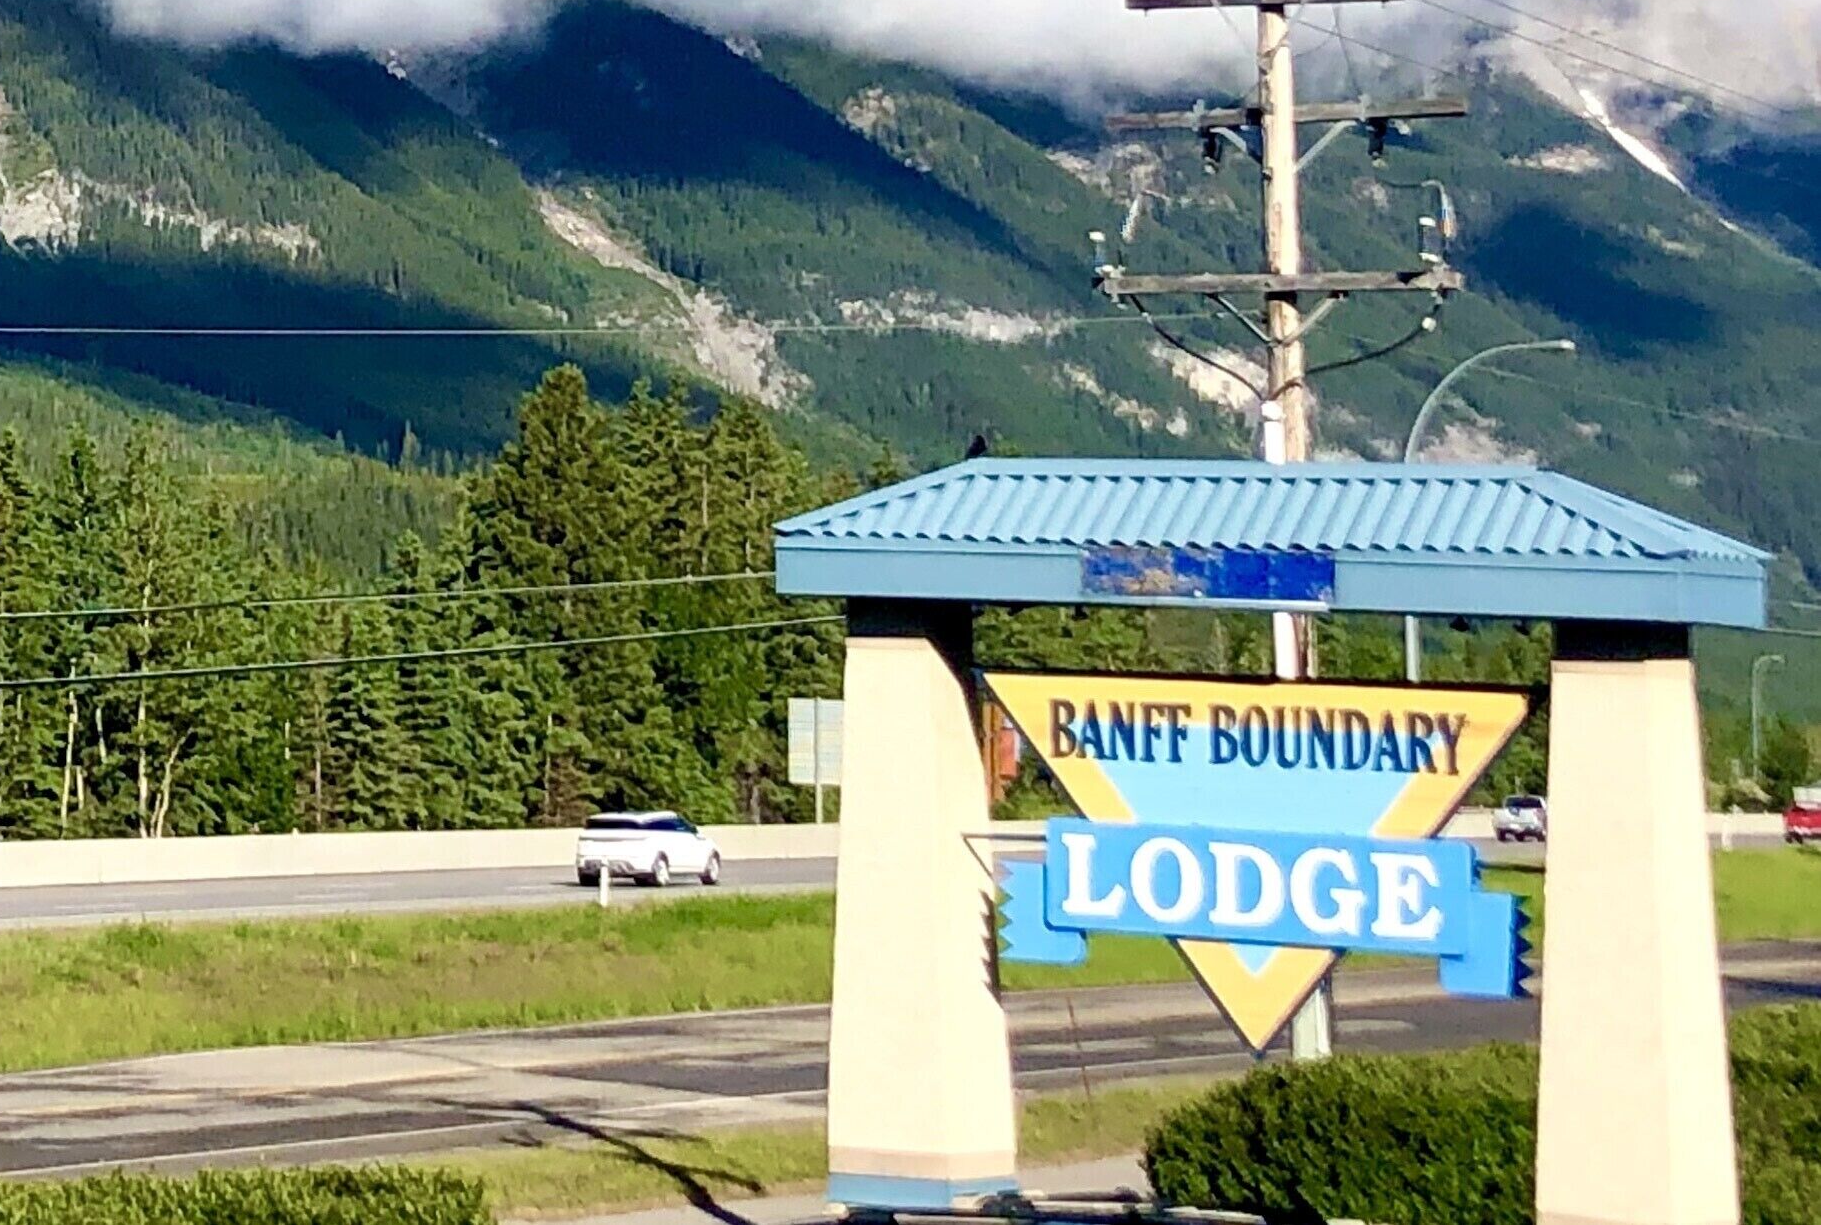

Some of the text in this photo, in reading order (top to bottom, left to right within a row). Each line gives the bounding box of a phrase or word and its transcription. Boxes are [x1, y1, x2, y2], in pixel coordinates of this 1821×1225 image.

[1049, 698, 1469, 776] BANFF BOUNDARY
[1061, 832, 1442, 939] LODGE
